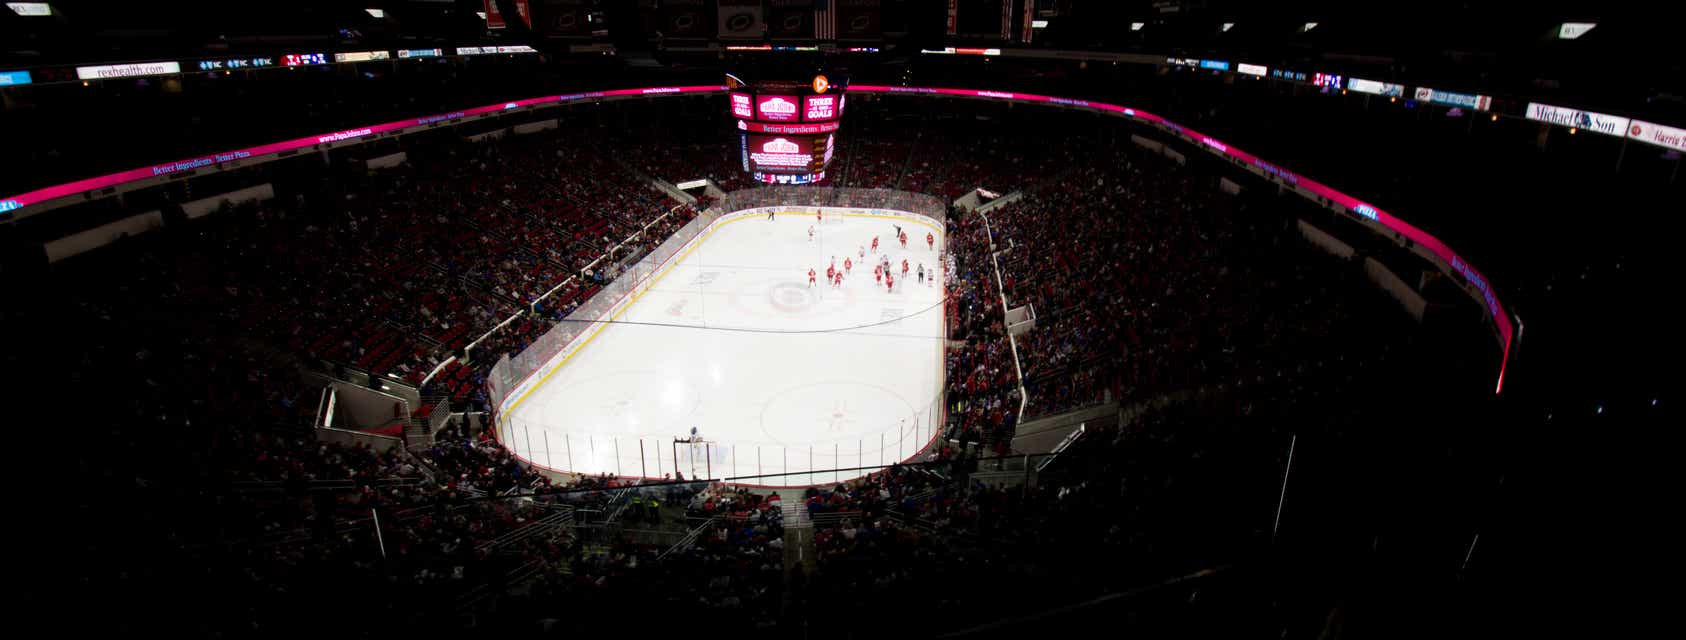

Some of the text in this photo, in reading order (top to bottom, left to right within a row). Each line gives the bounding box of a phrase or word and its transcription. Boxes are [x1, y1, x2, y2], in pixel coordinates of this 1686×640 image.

[96, 64, 165, 78] rexhealth.com
[809, 98, 832, 106] THREE
[808, 110, 832, 118] GOALS
[1535, 104, 1574, 127] Michael
[1595, 115, 1616, 134] Son
